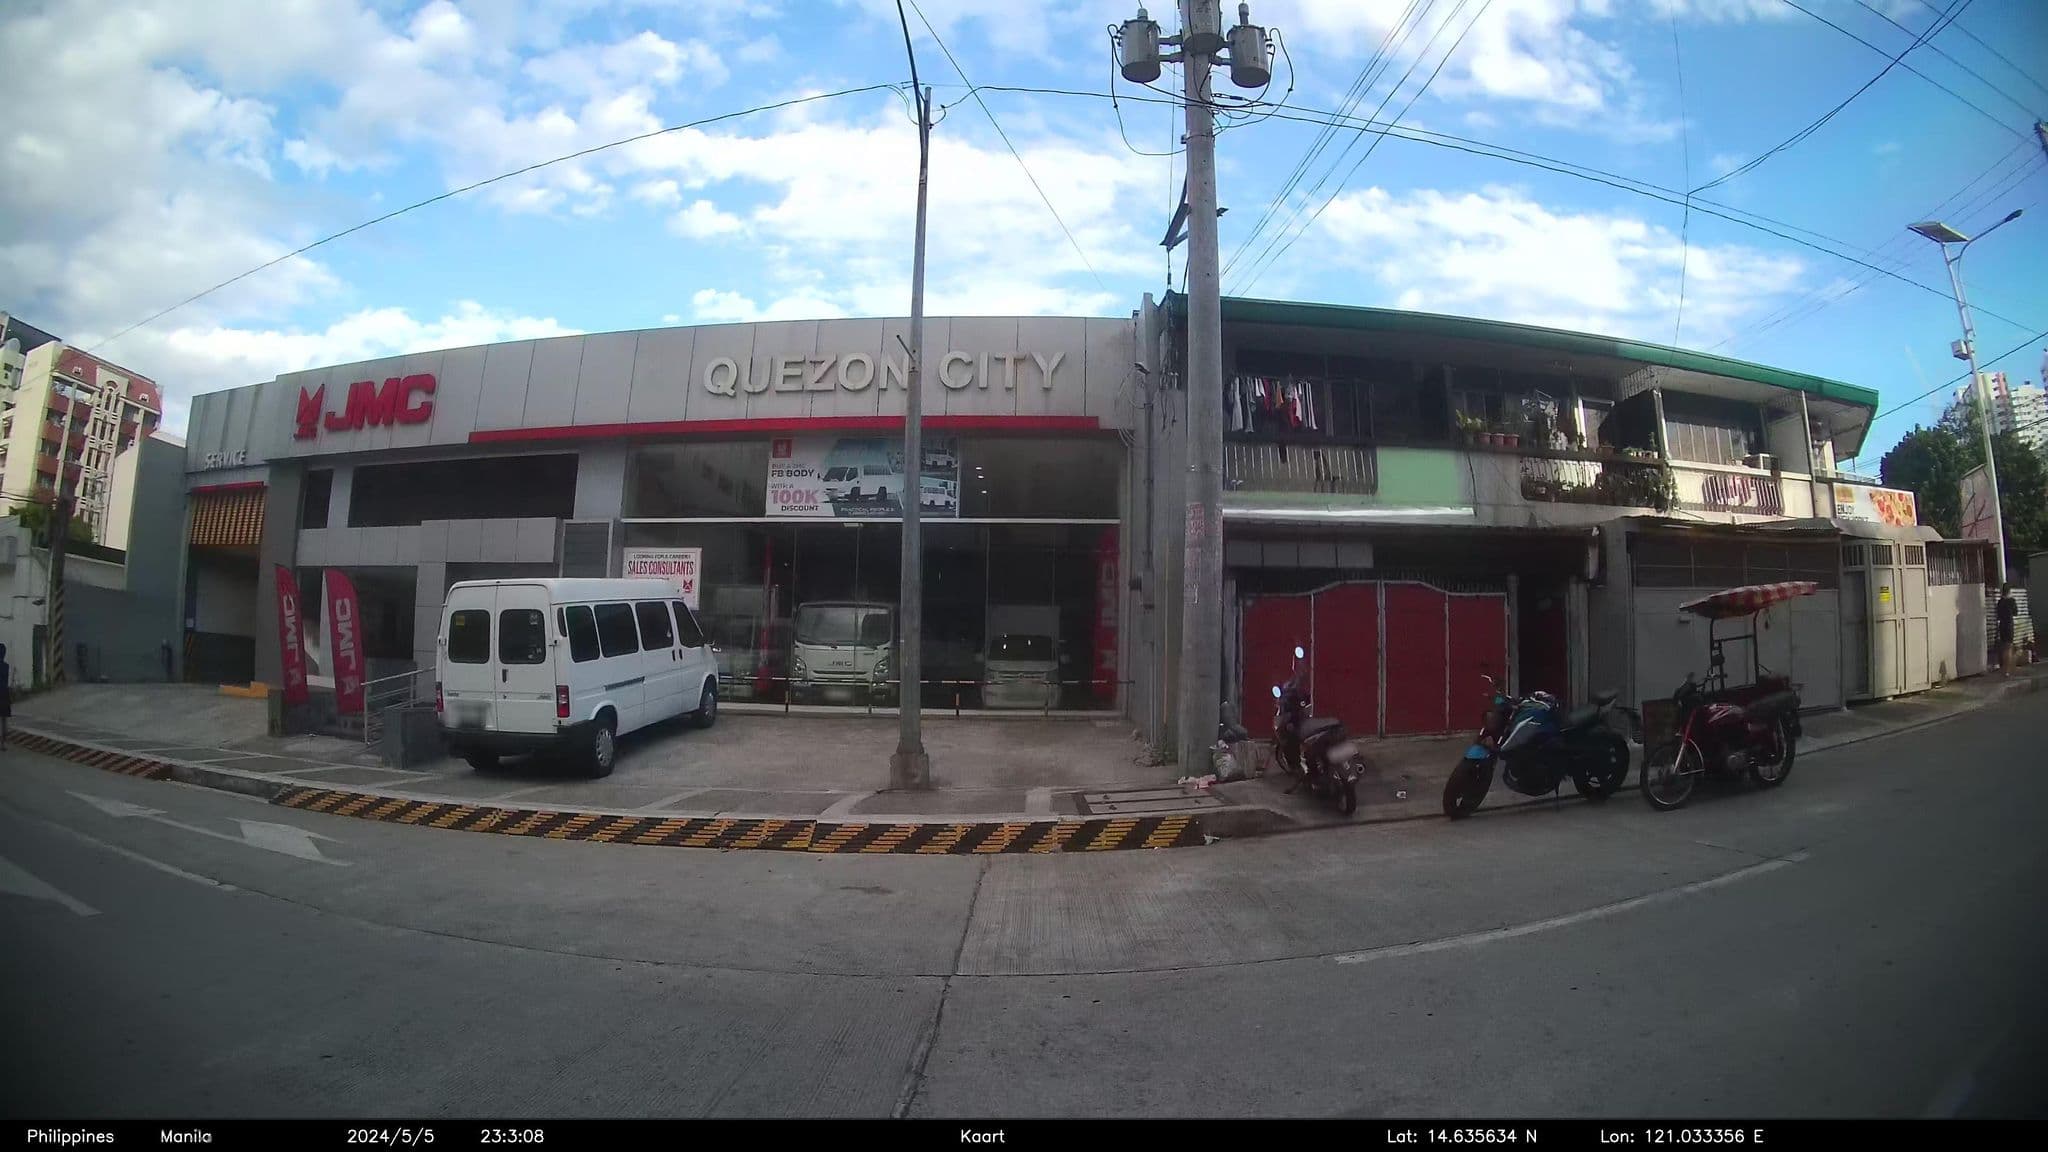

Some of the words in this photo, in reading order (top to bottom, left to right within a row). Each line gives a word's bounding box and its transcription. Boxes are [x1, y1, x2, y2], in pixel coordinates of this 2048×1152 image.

[704, 352, 911, 397] QUEZON
[938, 351, 1066, 391] CITY
[324, 373, 437, 432] JMC
[204, 450, 247, 471] SERVICE
[771, 469, 785, 478] FB
[786, 468, 815, 478] BODY
[771, 488, 818, 504] 100K
[628, 560, 648, 575] SALES
[648, 560, 694, 576] CONSULTANTS
[283, 594, 299, 663] JMC
[336, 597, 357, 670] JMC
